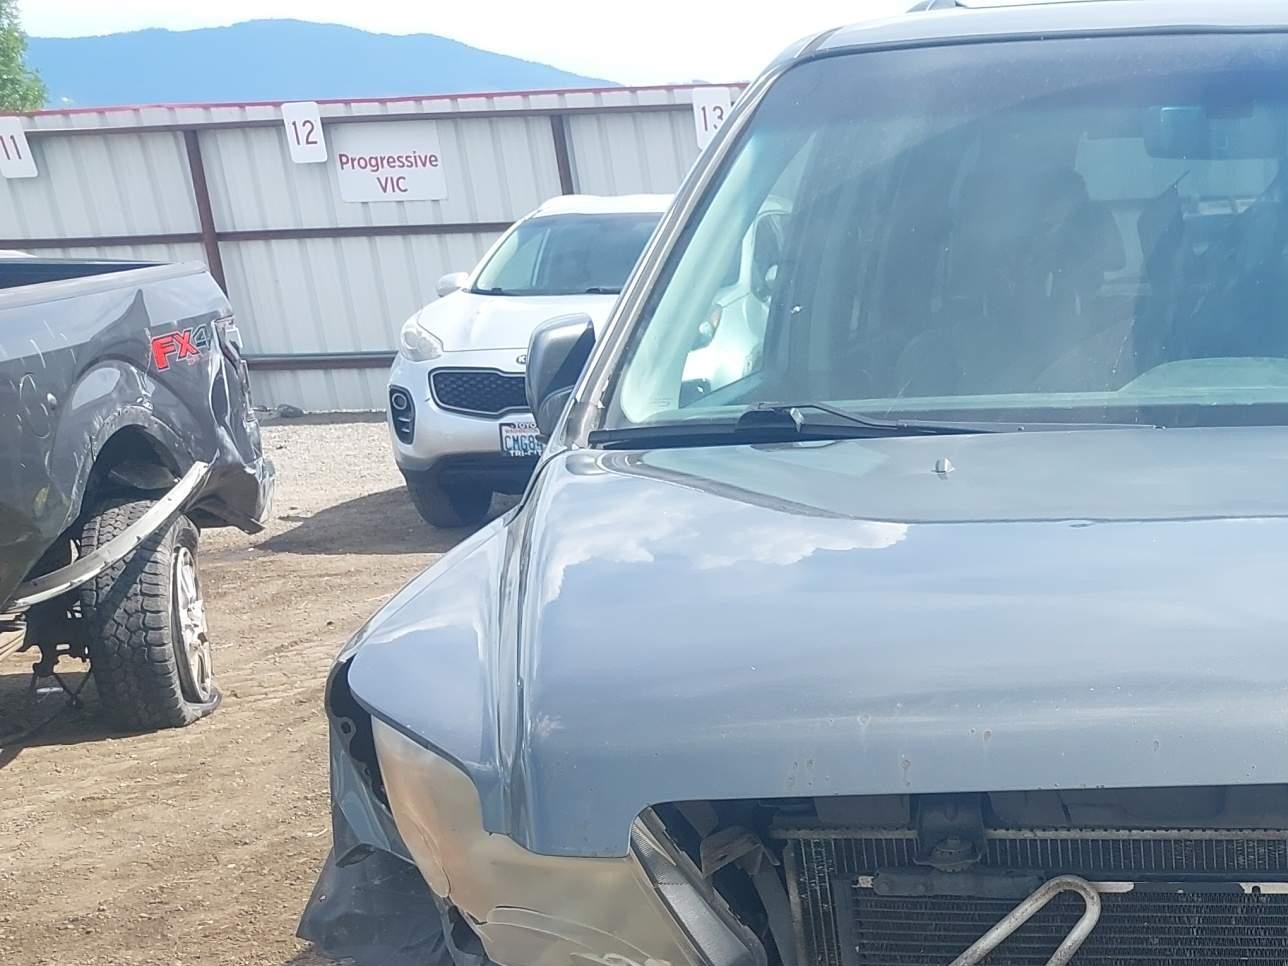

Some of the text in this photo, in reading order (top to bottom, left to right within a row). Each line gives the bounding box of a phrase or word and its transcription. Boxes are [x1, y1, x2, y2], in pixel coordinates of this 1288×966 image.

[701, 105, 724, 132] 13
[292, 119, 319, 146] 12
[0, 134, 22, 161] 11
[338, 151, 439, 173] Progressive
[376, 176, 408, 194] VIC
[151, 323, 213, 372] FX4
